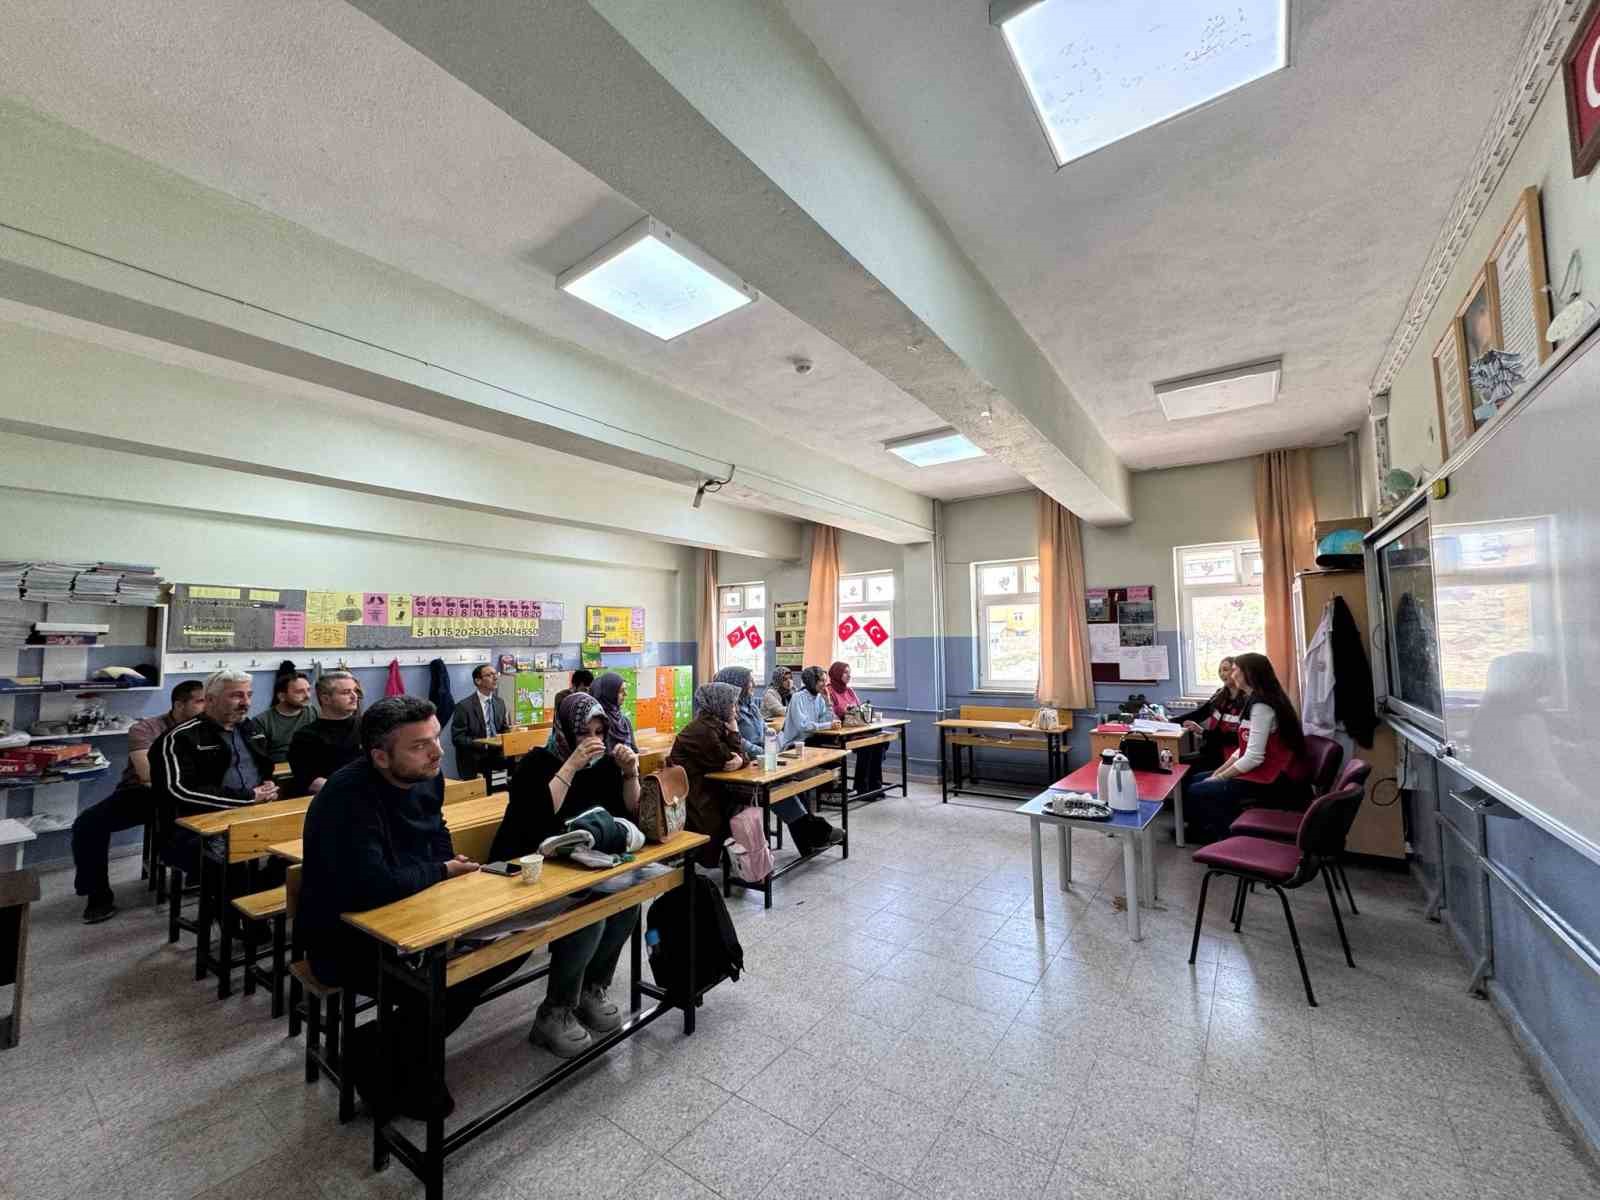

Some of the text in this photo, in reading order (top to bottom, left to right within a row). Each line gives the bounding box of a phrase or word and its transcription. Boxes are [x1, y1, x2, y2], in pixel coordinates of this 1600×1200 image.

[417, 606, 542, 618] 2 4 6 8 10 12 14 16 18 20
[417, 627, 538, 637] 5 10 15 20 25 30 35 40 45 50
